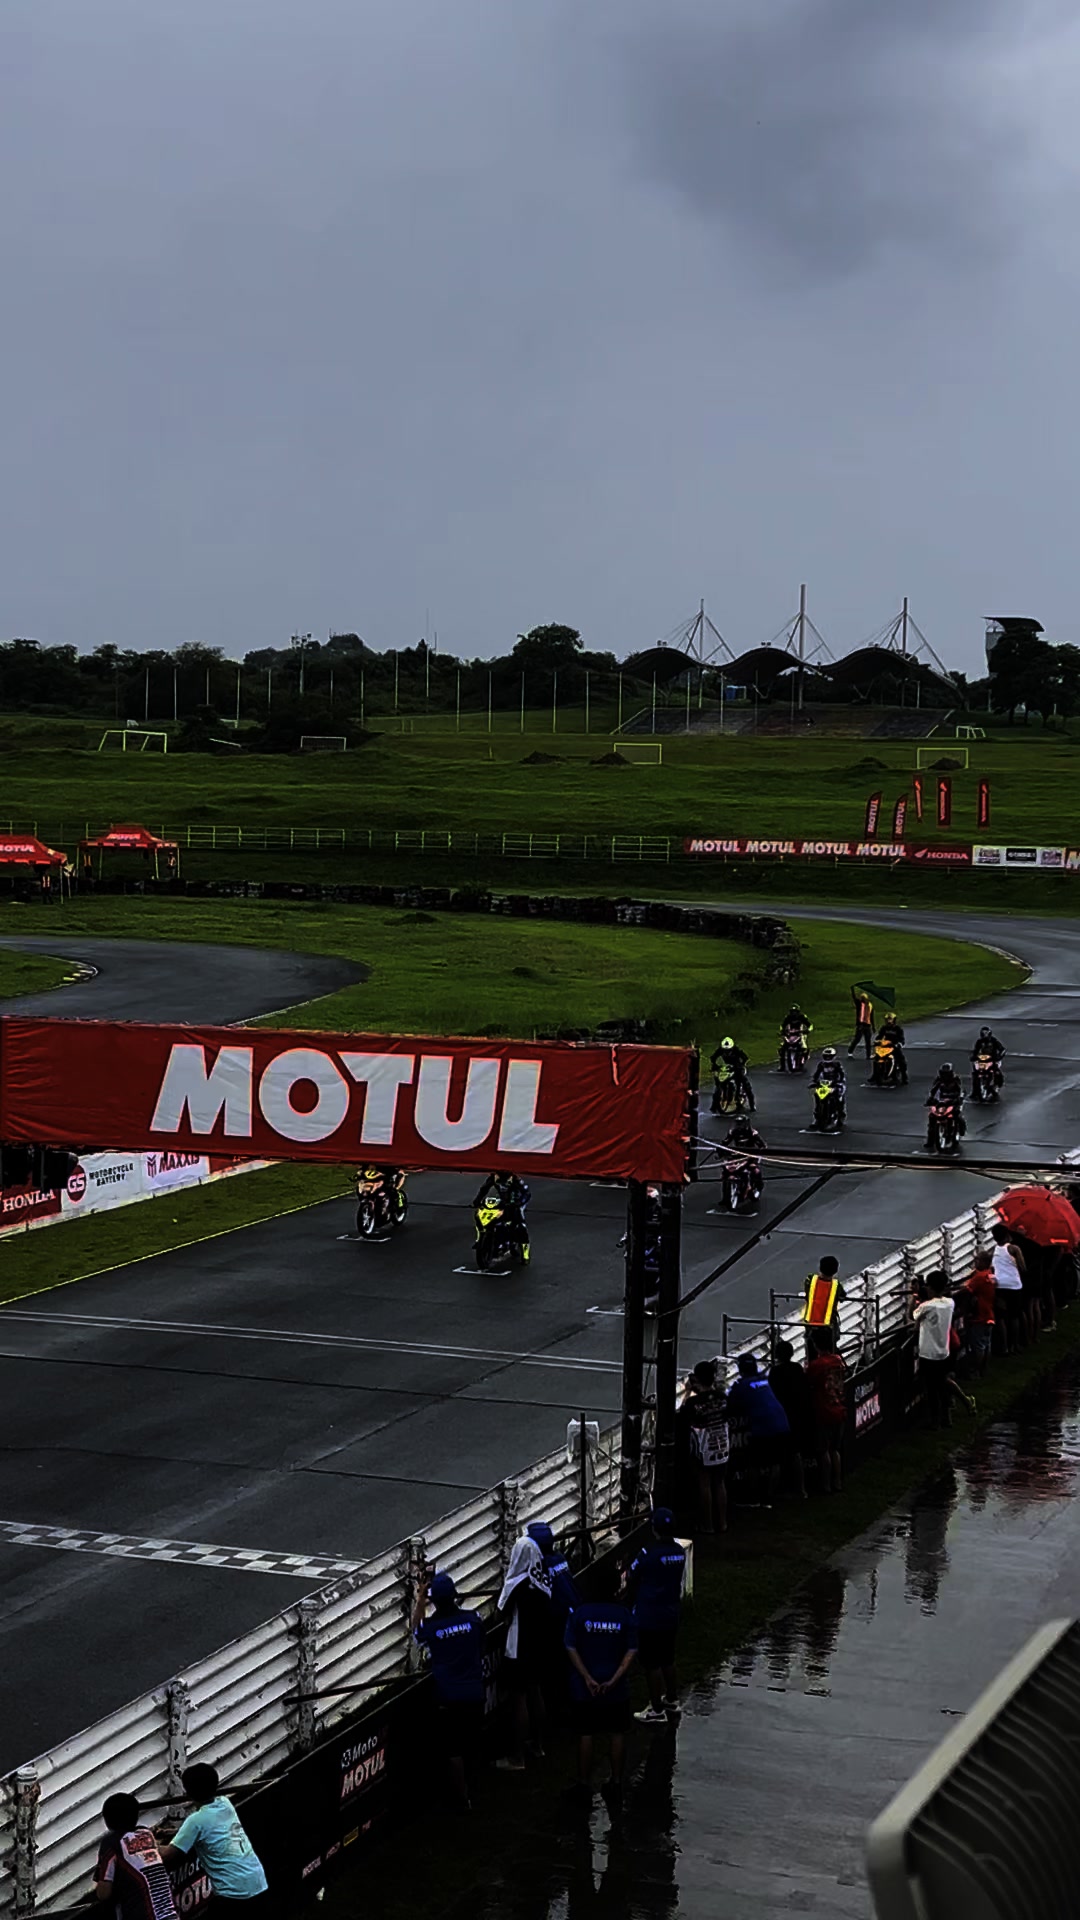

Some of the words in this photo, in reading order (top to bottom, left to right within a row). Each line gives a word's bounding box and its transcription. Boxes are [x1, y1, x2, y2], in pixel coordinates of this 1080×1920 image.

[868, 799, 879, 833] MOTUL
[690, 840, 741, 852] MOTUL
[745, 840, 796, 853] MOTUL
[801, 842, 851, 855] MOTUL
[856, 843, 907, 857] MOTUL
[927, 852, 968, 860] HONDA
[150, 1043, 560, 1154] MOTUL
[67, 1173, 85, 1193] GS
[855, 1393, 881, 1429] MOTUL
[444, 1621, 472, 1636] YAMAHA
[593, 1622, 622, 1632] YAMAHA
[341, 1748, 385, 1798] MOTUL
[175, 1874, 213, 1913] OTU
